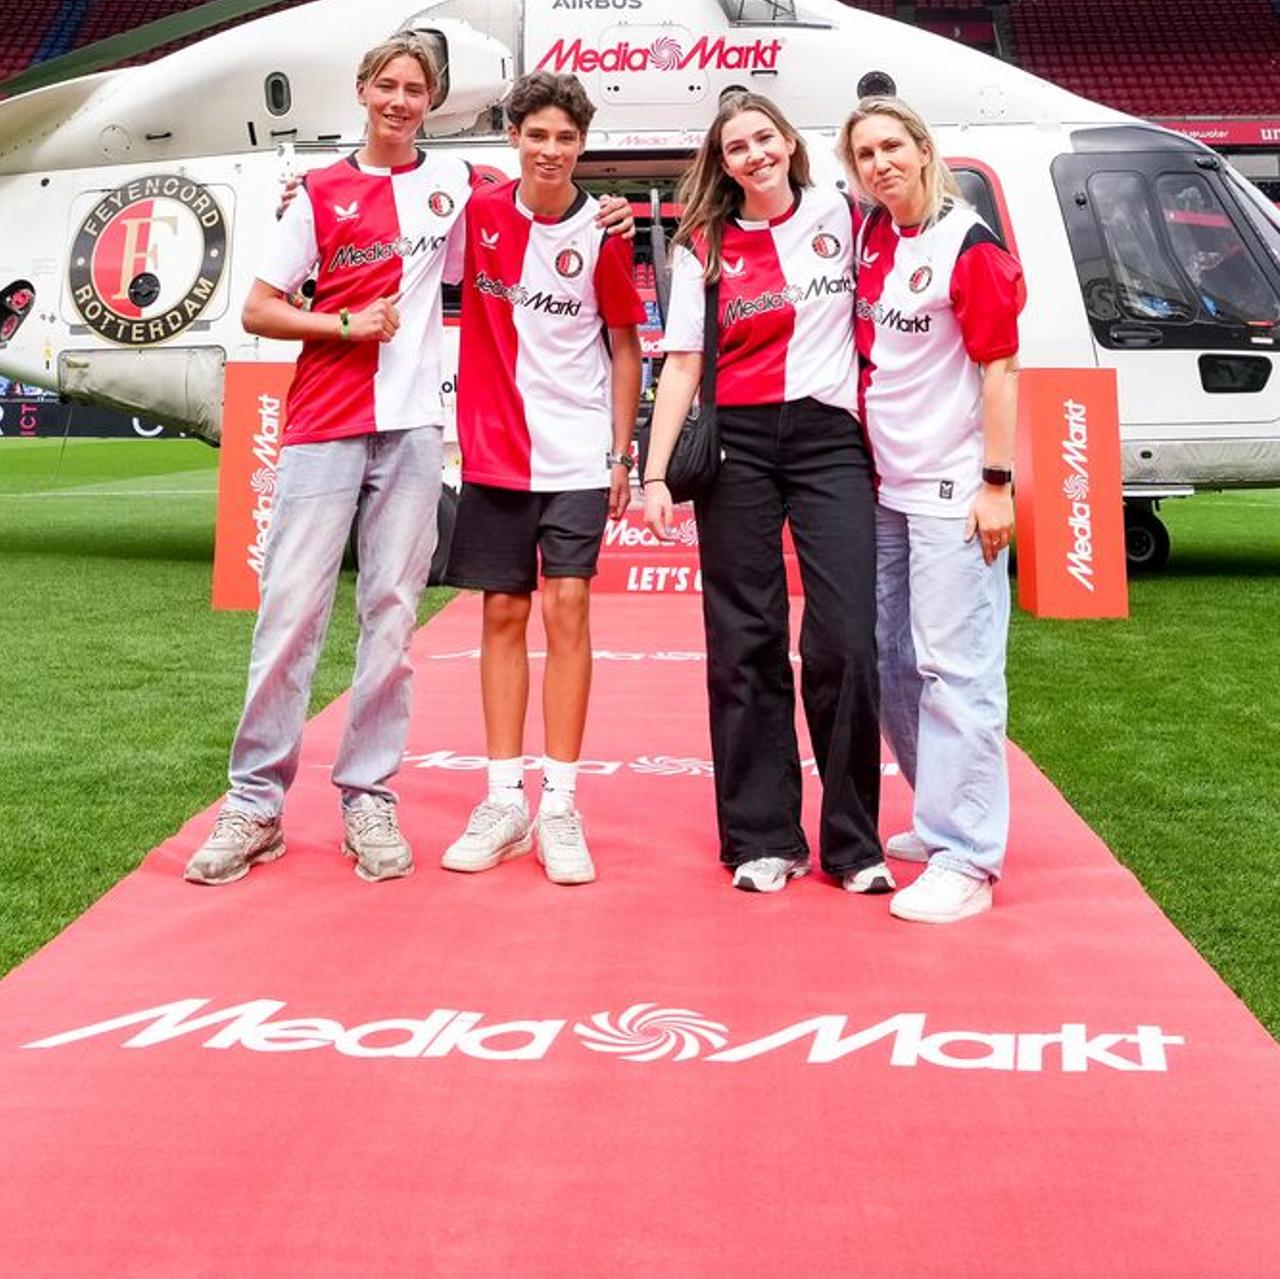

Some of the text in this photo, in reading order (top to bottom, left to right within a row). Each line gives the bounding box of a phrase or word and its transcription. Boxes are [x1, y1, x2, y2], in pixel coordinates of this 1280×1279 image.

[534, 35, 783, 73] Media Markt
[84, 177, 220, 238] FEYENOORD
[75, 276, 215, 342] ROTTERDAM
[723, 275, 853, 328] Media Mark
[881, 308, 931, 332] Markt
[252, 394, 280, 470] Markt
[1061, 398, 1095, 592] Media Markt
[605, 519, 676, 547] Med
[627, 566, 691, 592] LET'S
[20, 998, 1186, 1072] Media Markt
